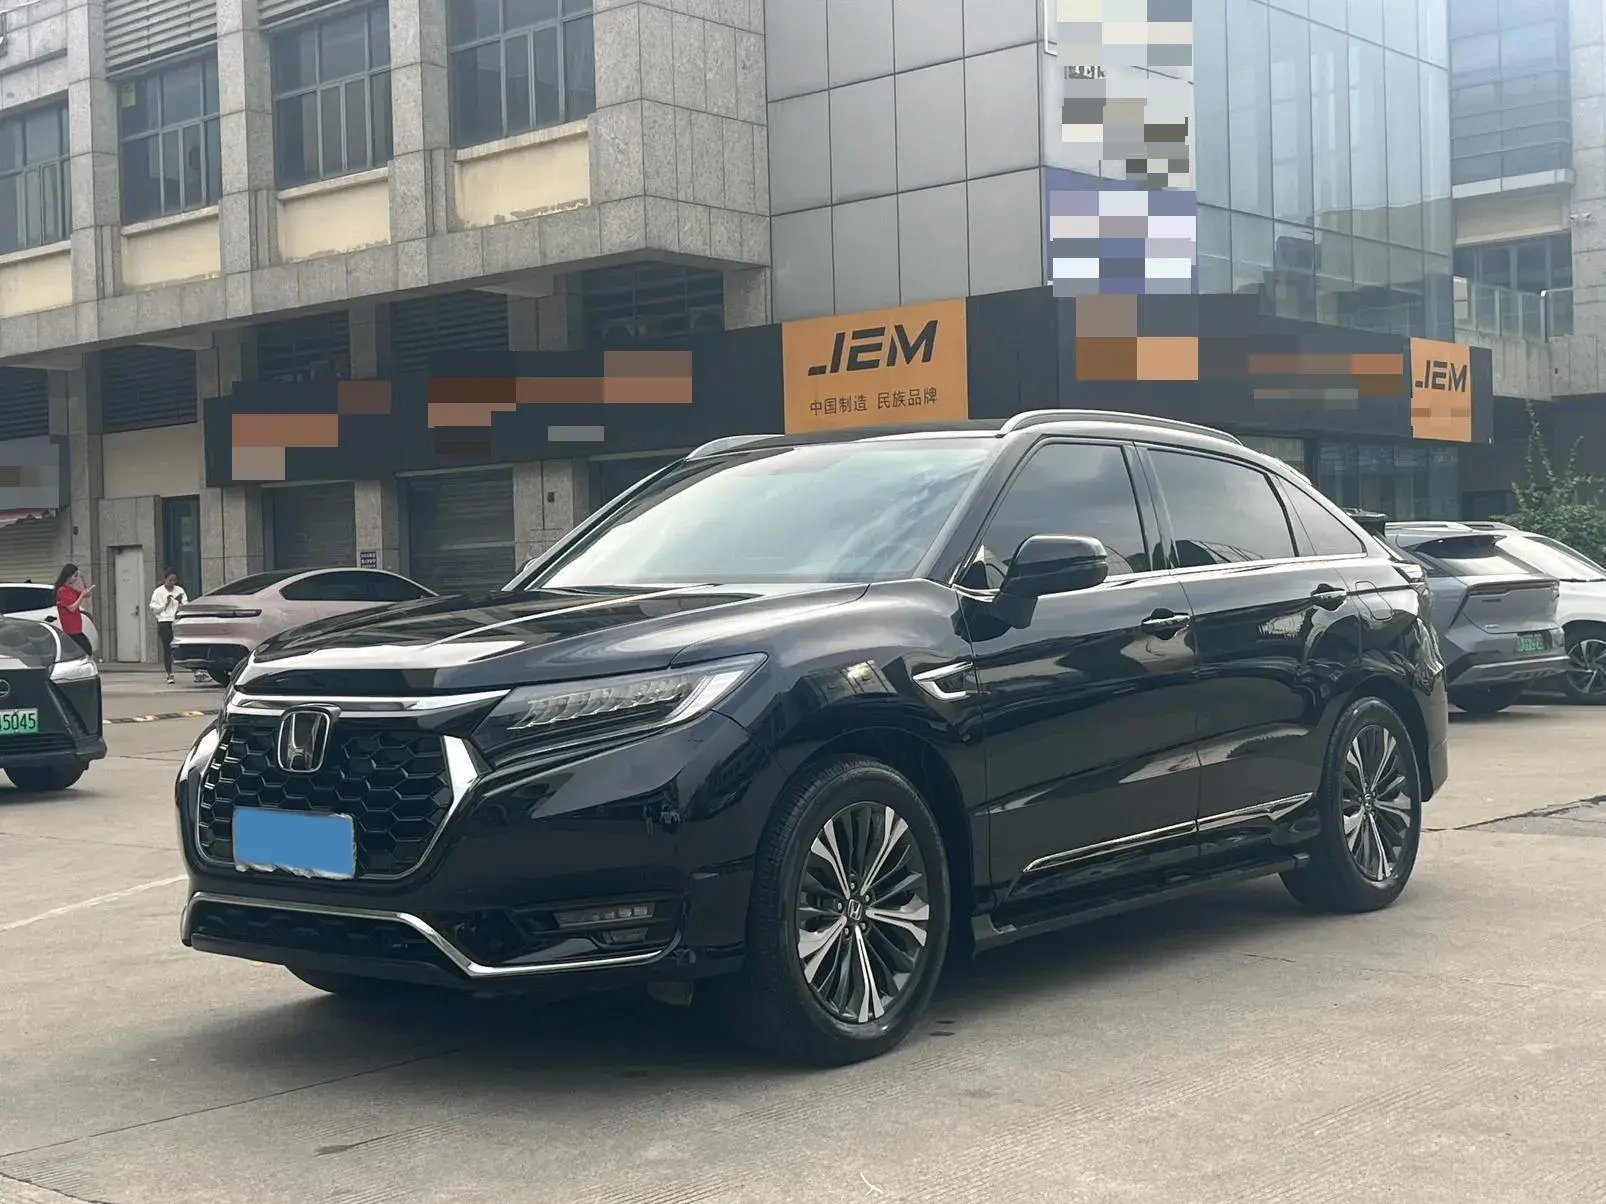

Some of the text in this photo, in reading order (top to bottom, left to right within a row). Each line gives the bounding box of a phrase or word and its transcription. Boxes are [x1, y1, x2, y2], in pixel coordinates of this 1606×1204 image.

[808, 320, 938, 376] JEM
[1415, 360, 1467, 392] JEM
[809, 387, 937, 416] 中国制造 民族品牌
[0, 713, 36, 730] 5045
